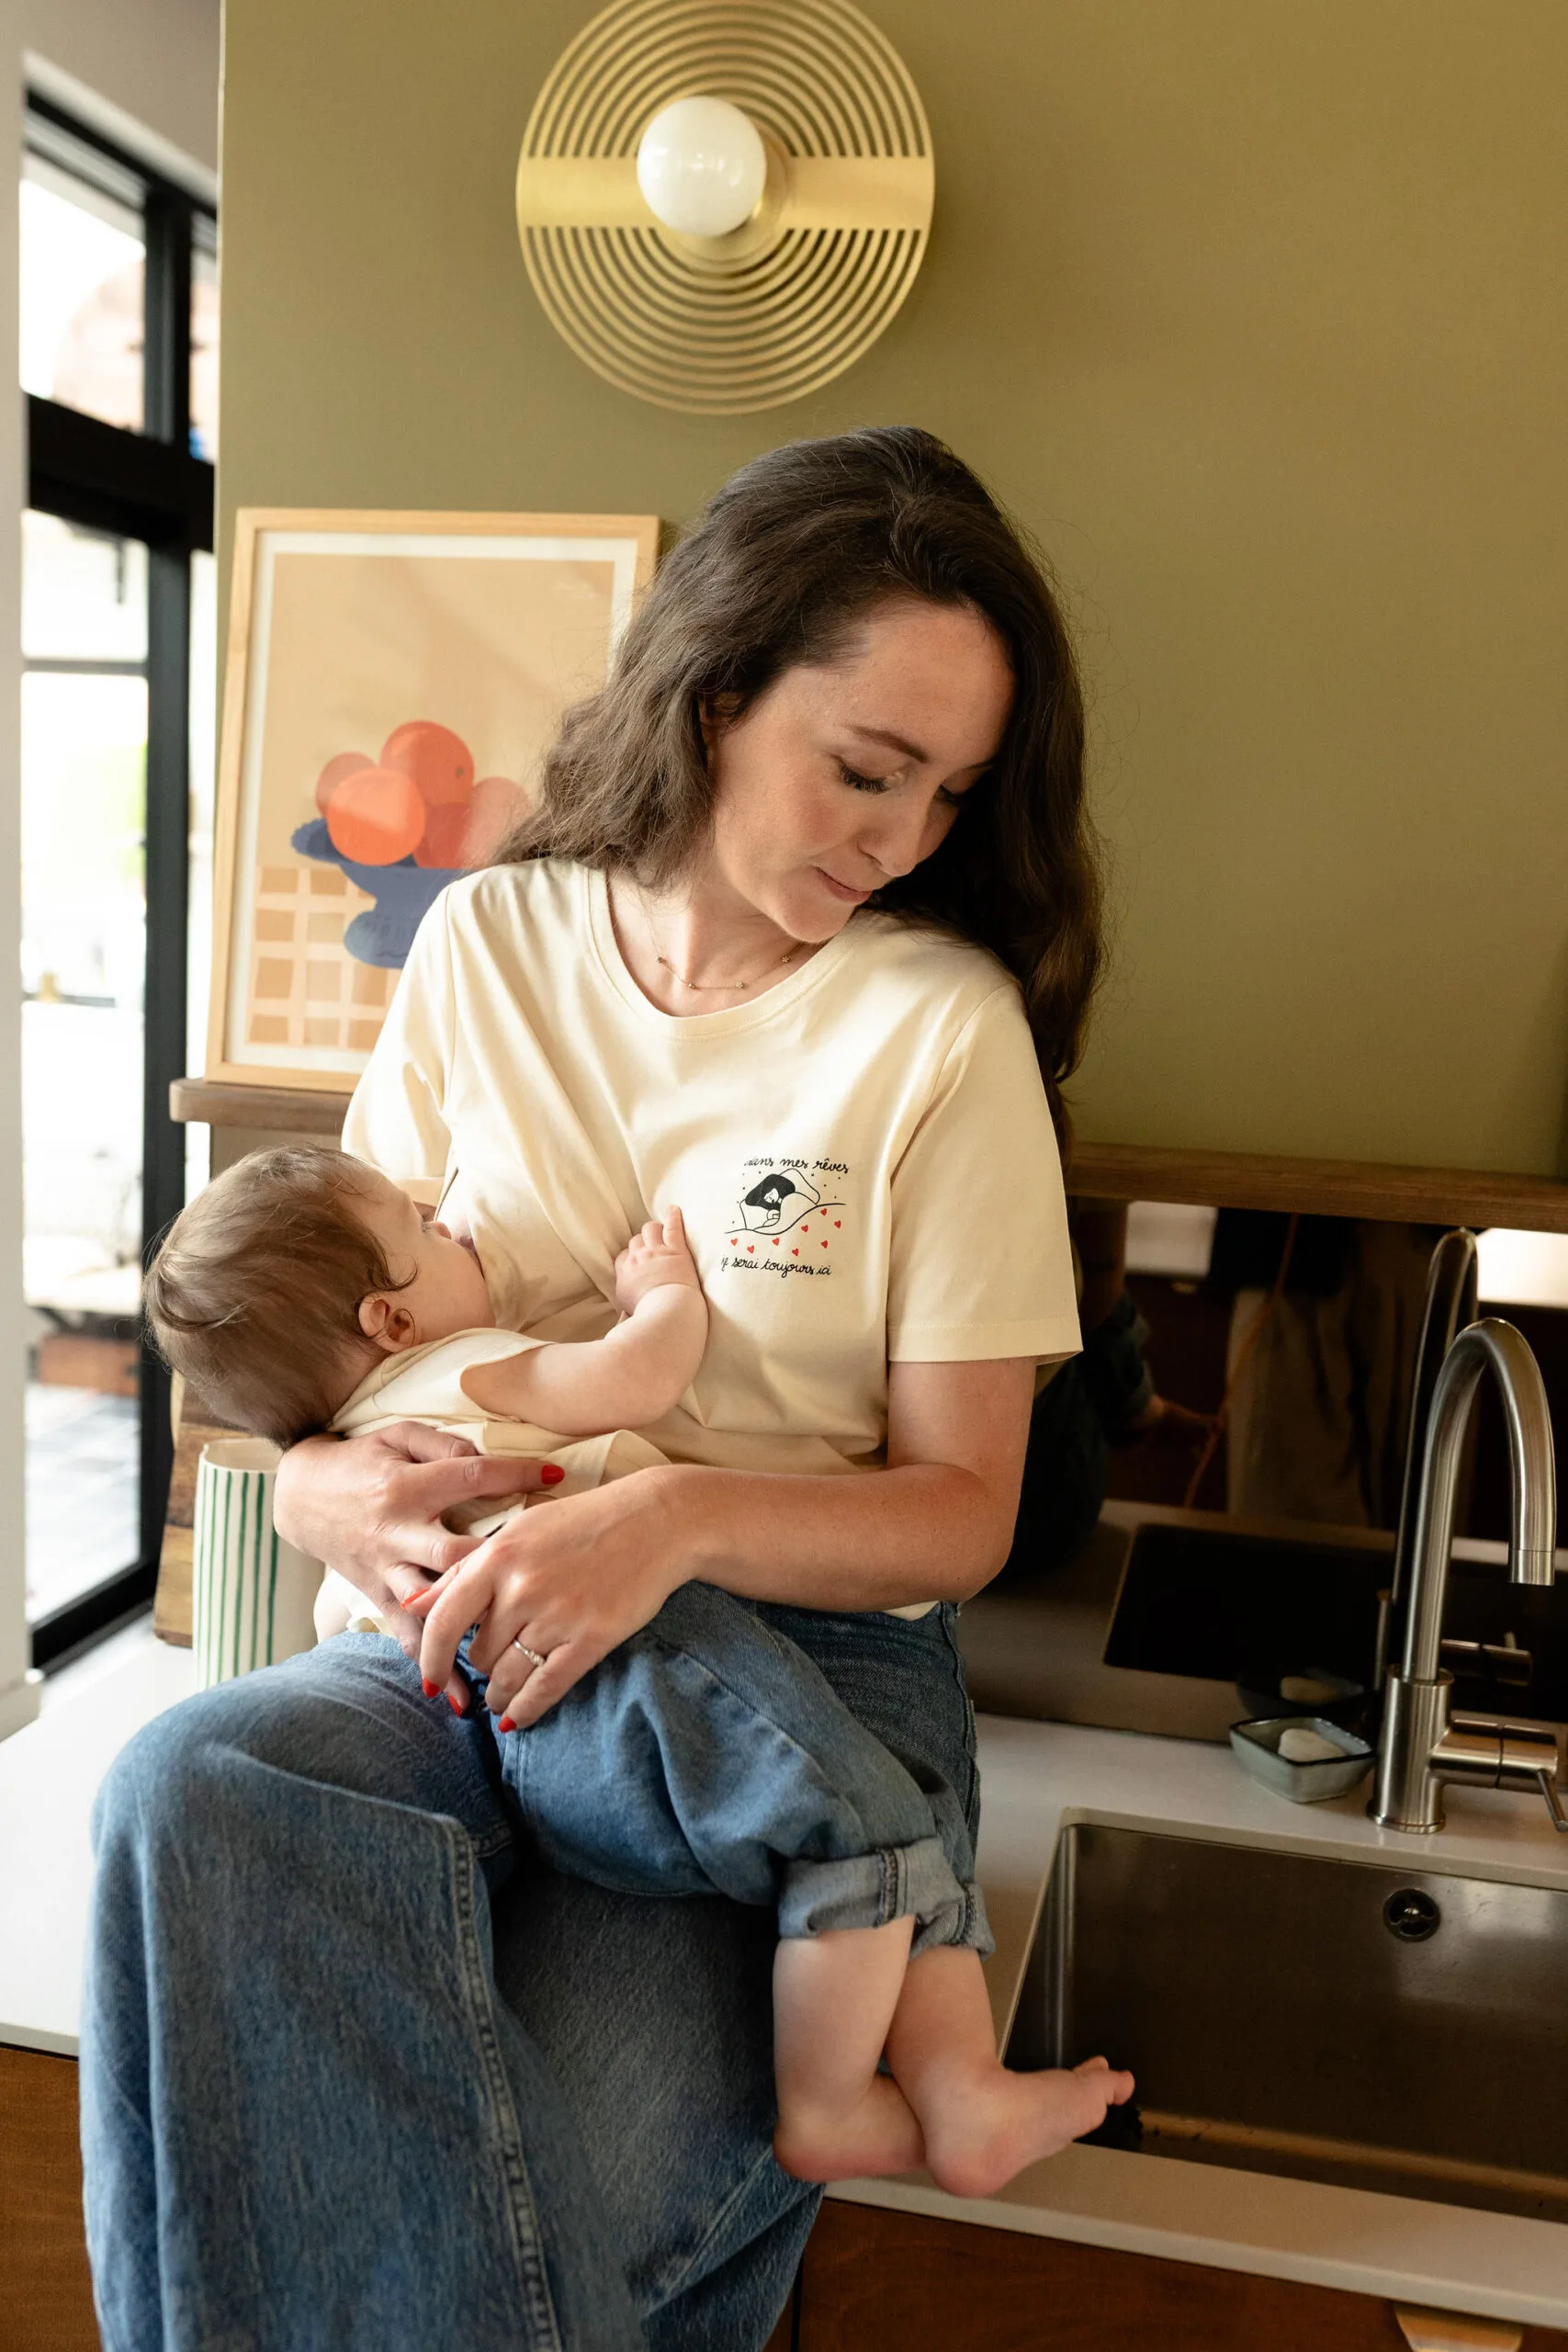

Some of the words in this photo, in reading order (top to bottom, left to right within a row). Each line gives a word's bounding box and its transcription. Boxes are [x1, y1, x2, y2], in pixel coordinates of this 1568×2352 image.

[779, 1159, 808, 1170] mes
[812, 1158, 849, 1174] rêves
[731, 1257, 759, 1270] serai
[761, 1258, 814, 1278] toujours
[816, 1264, 831, 1275] ici
